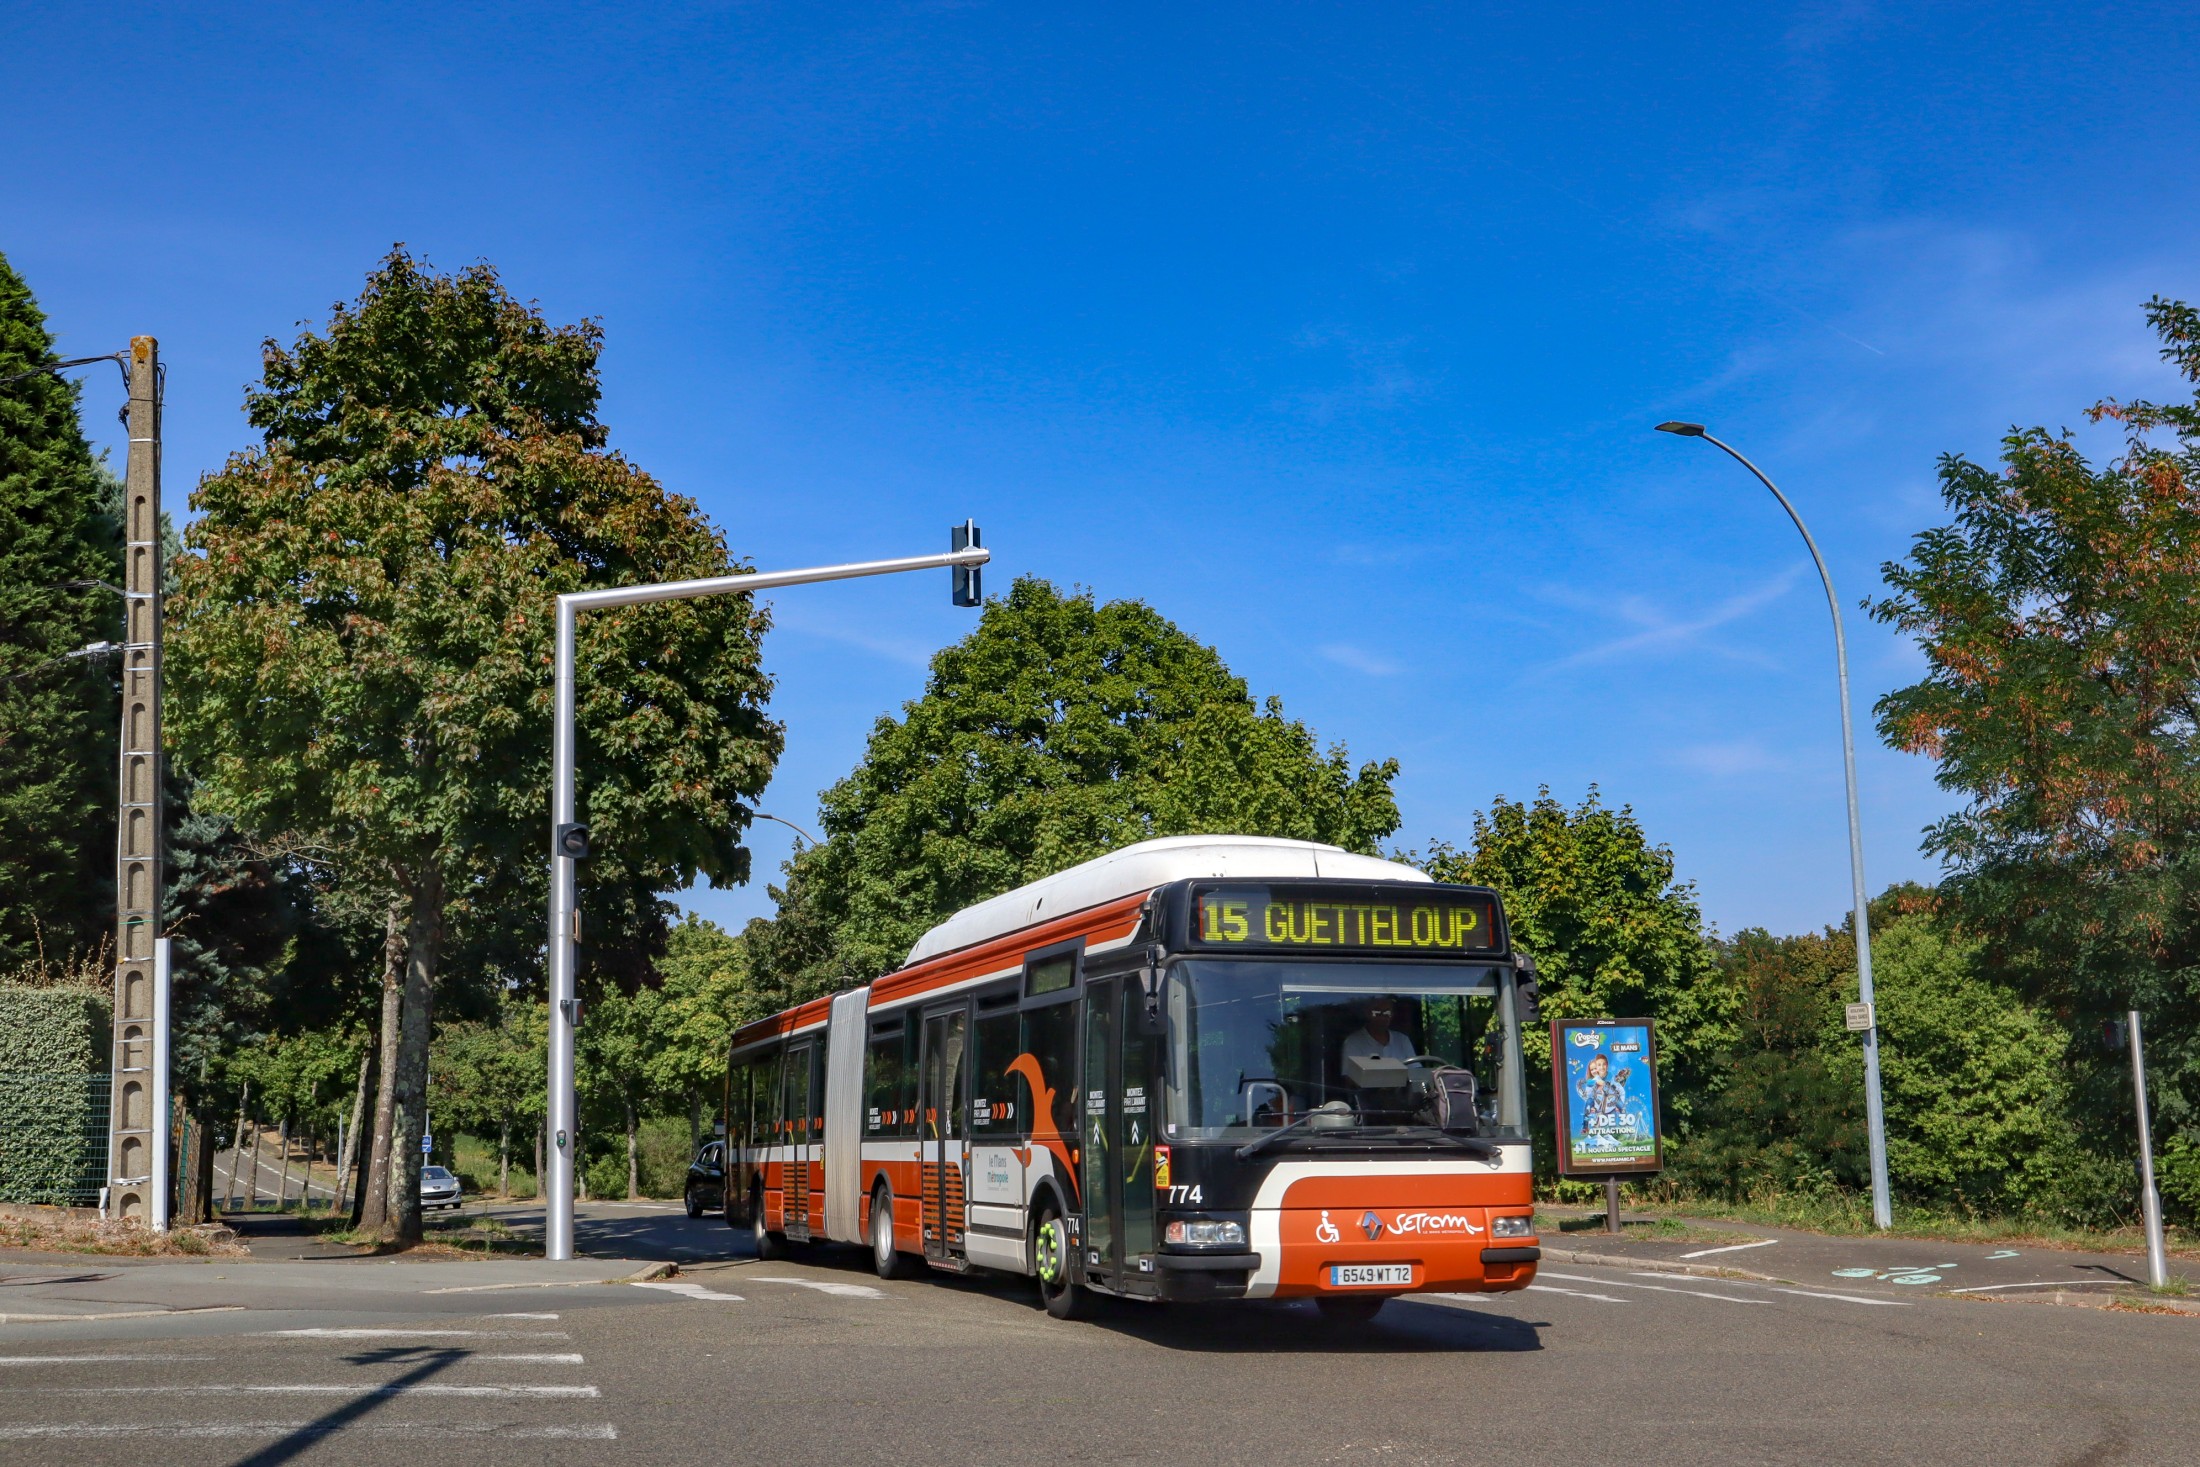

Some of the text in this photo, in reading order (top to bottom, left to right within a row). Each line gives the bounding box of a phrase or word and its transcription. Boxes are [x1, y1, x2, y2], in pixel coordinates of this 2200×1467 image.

[1204, 901, 1477, 947] 15 GUETTELOUP
[1599, 1114, 1616, 1126] DE
[1619, 1113, 1635, 1125] 30
[1588, 1127, 1636, 1135] ATTRACTIONS
[1169, 1185, 1203, 1203] 774
[1067, 1218, 1079, 1234] 774
[1343, 1268, 1409, 1282] 6549 WT 72
